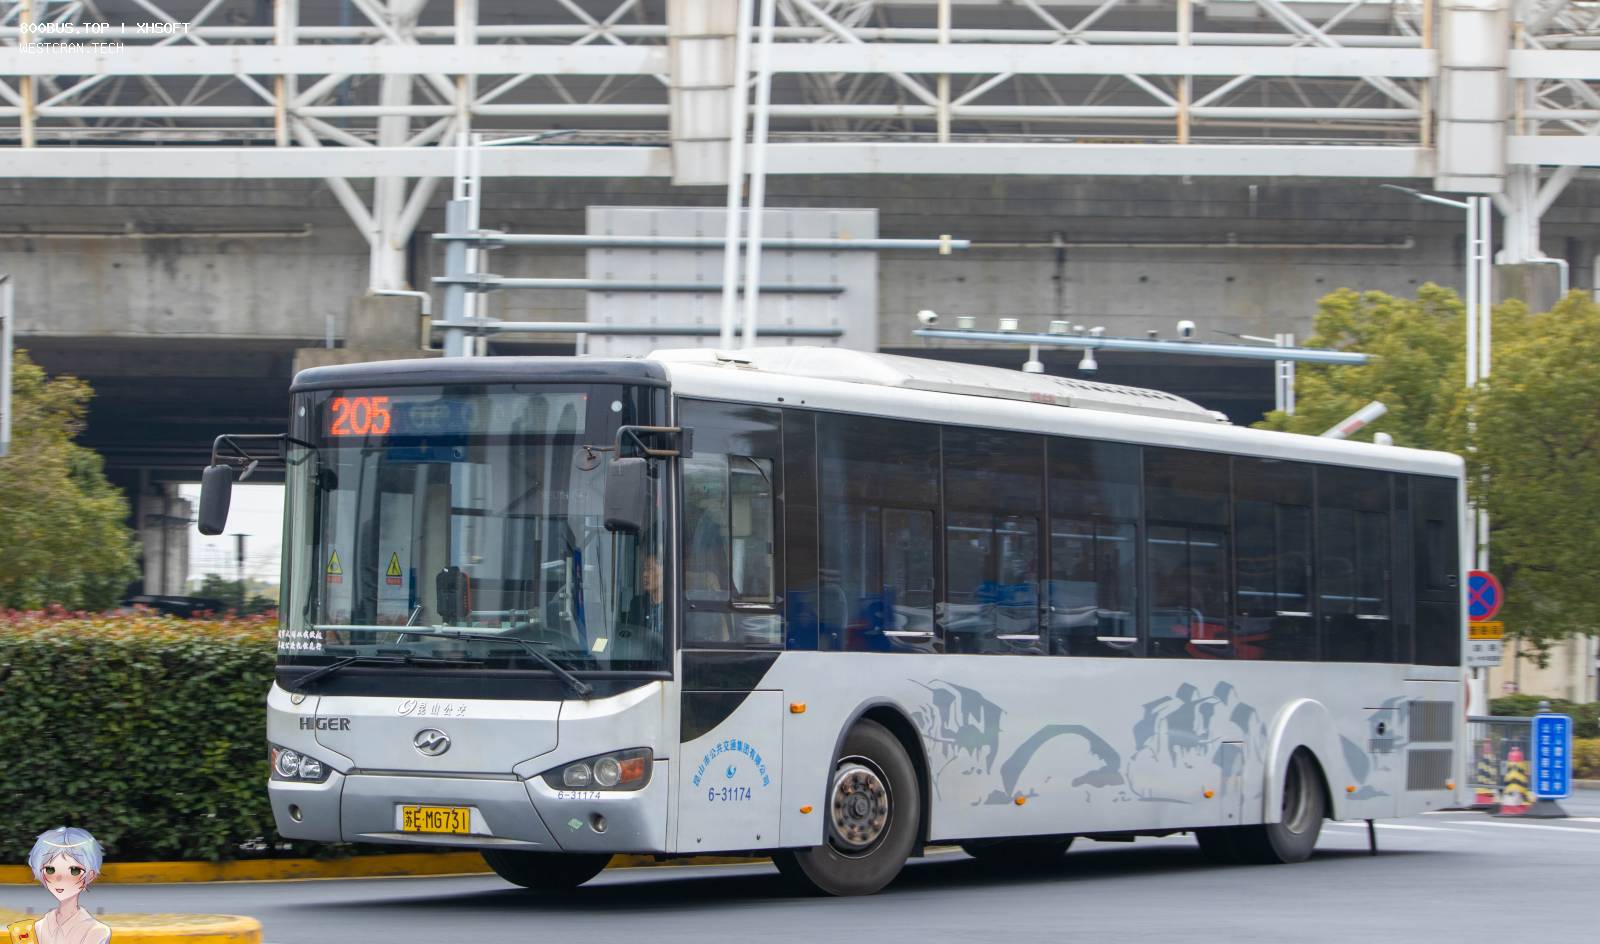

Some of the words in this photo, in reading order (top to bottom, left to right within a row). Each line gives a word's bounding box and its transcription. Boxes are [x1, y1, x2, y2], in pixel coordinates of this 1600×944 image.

[329, 396, 392, 436] 205
[416, 703, 468, 717] 昆山公交
[299, 717, 351, 731] HIGER
[557, 791, 601, 800] 6-31174
[708, 787, 752, 802] 6-31174
